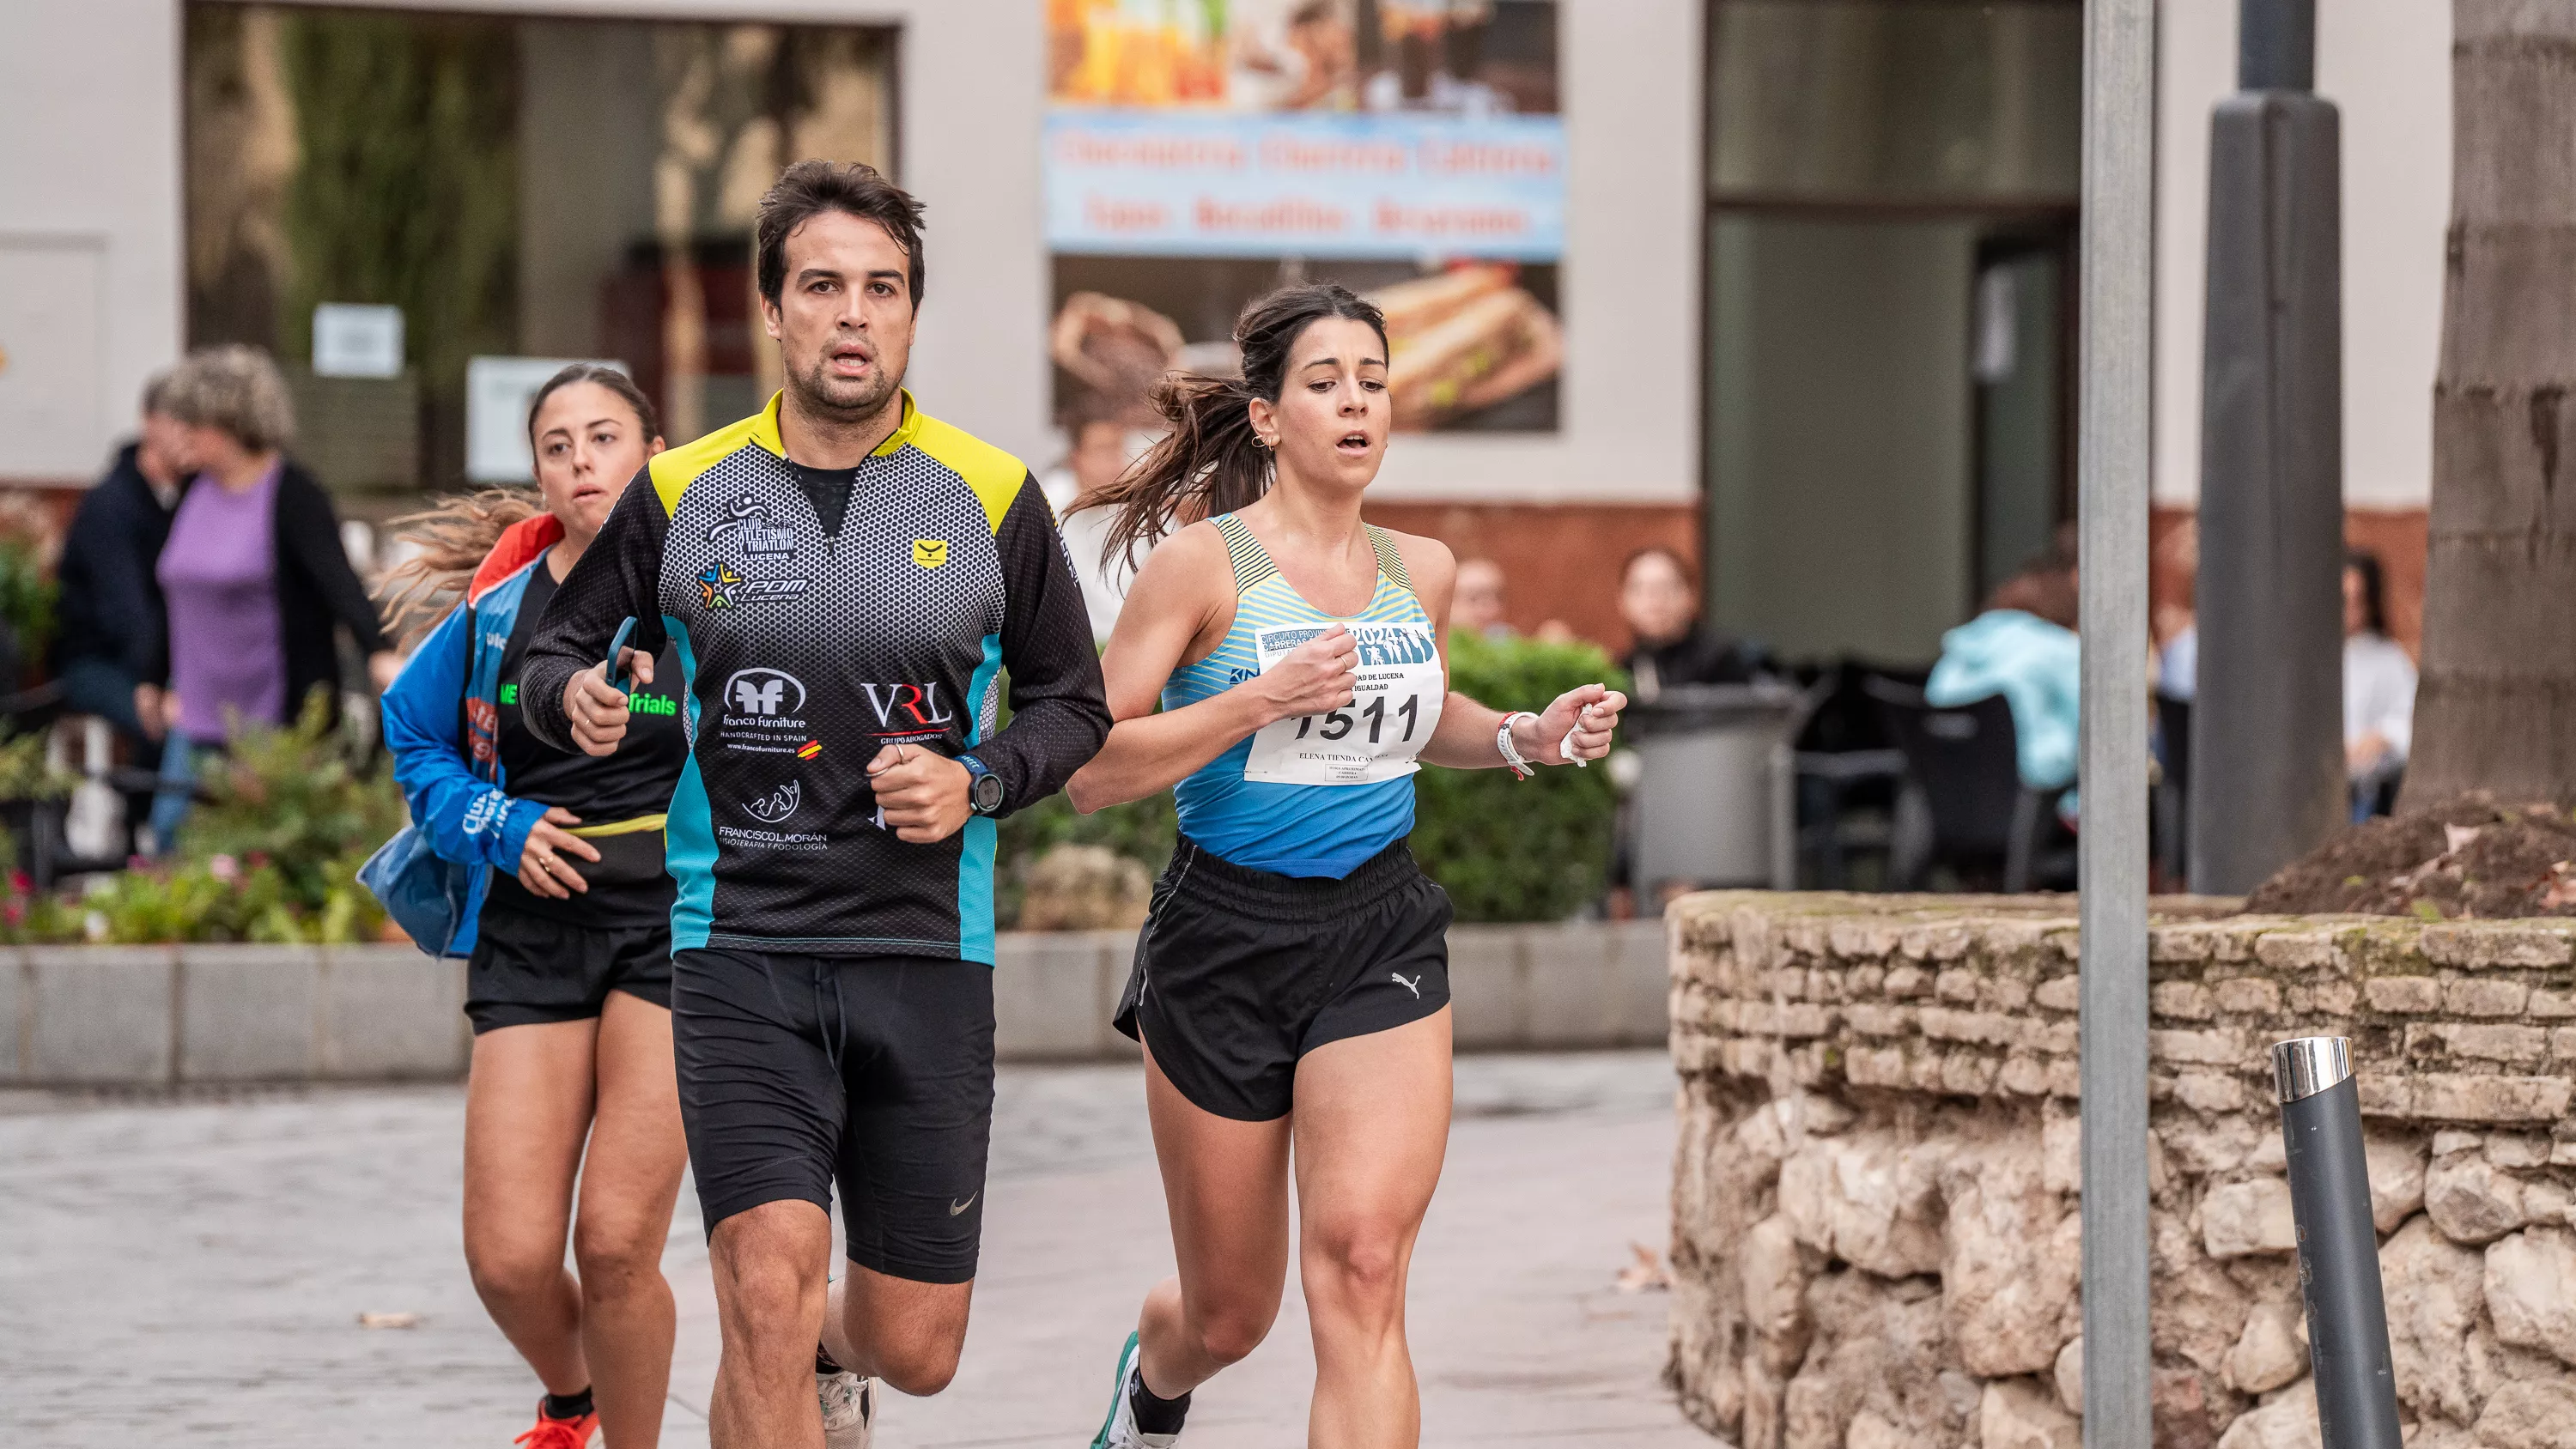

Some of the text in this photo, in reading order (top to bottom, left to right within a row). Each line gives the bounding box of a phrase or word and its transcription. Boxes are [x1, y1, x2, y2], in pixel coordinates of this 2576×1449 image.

[737, 518, 762, 530] CLUB
[738, 527, 793, 542] ATLETISMO
[744, 552, 790, 561] LUCENA
[744, 579, 808, 594] PDM
[740, 593, 799, 602] Lucena
[1261, 629, 1327, 644] CIRCUITO PROVIN
[1352, 627, 1399, 646] 2024
[1354, 683, 1388, 692] IGUALDAD
[860, 682, 952, 727] VRL
[723, 714, 806, 728] franco furniture
[720, 731, 771, 741] HANDCRAFTED
[727, 743, 795, 754] www.francofurniture.es
[1299, 752, 1325, 761] ELENA
[1327, 754, 1356, 762] TIENDA
[773, 841, 828, 851] PODOLOGÍA
